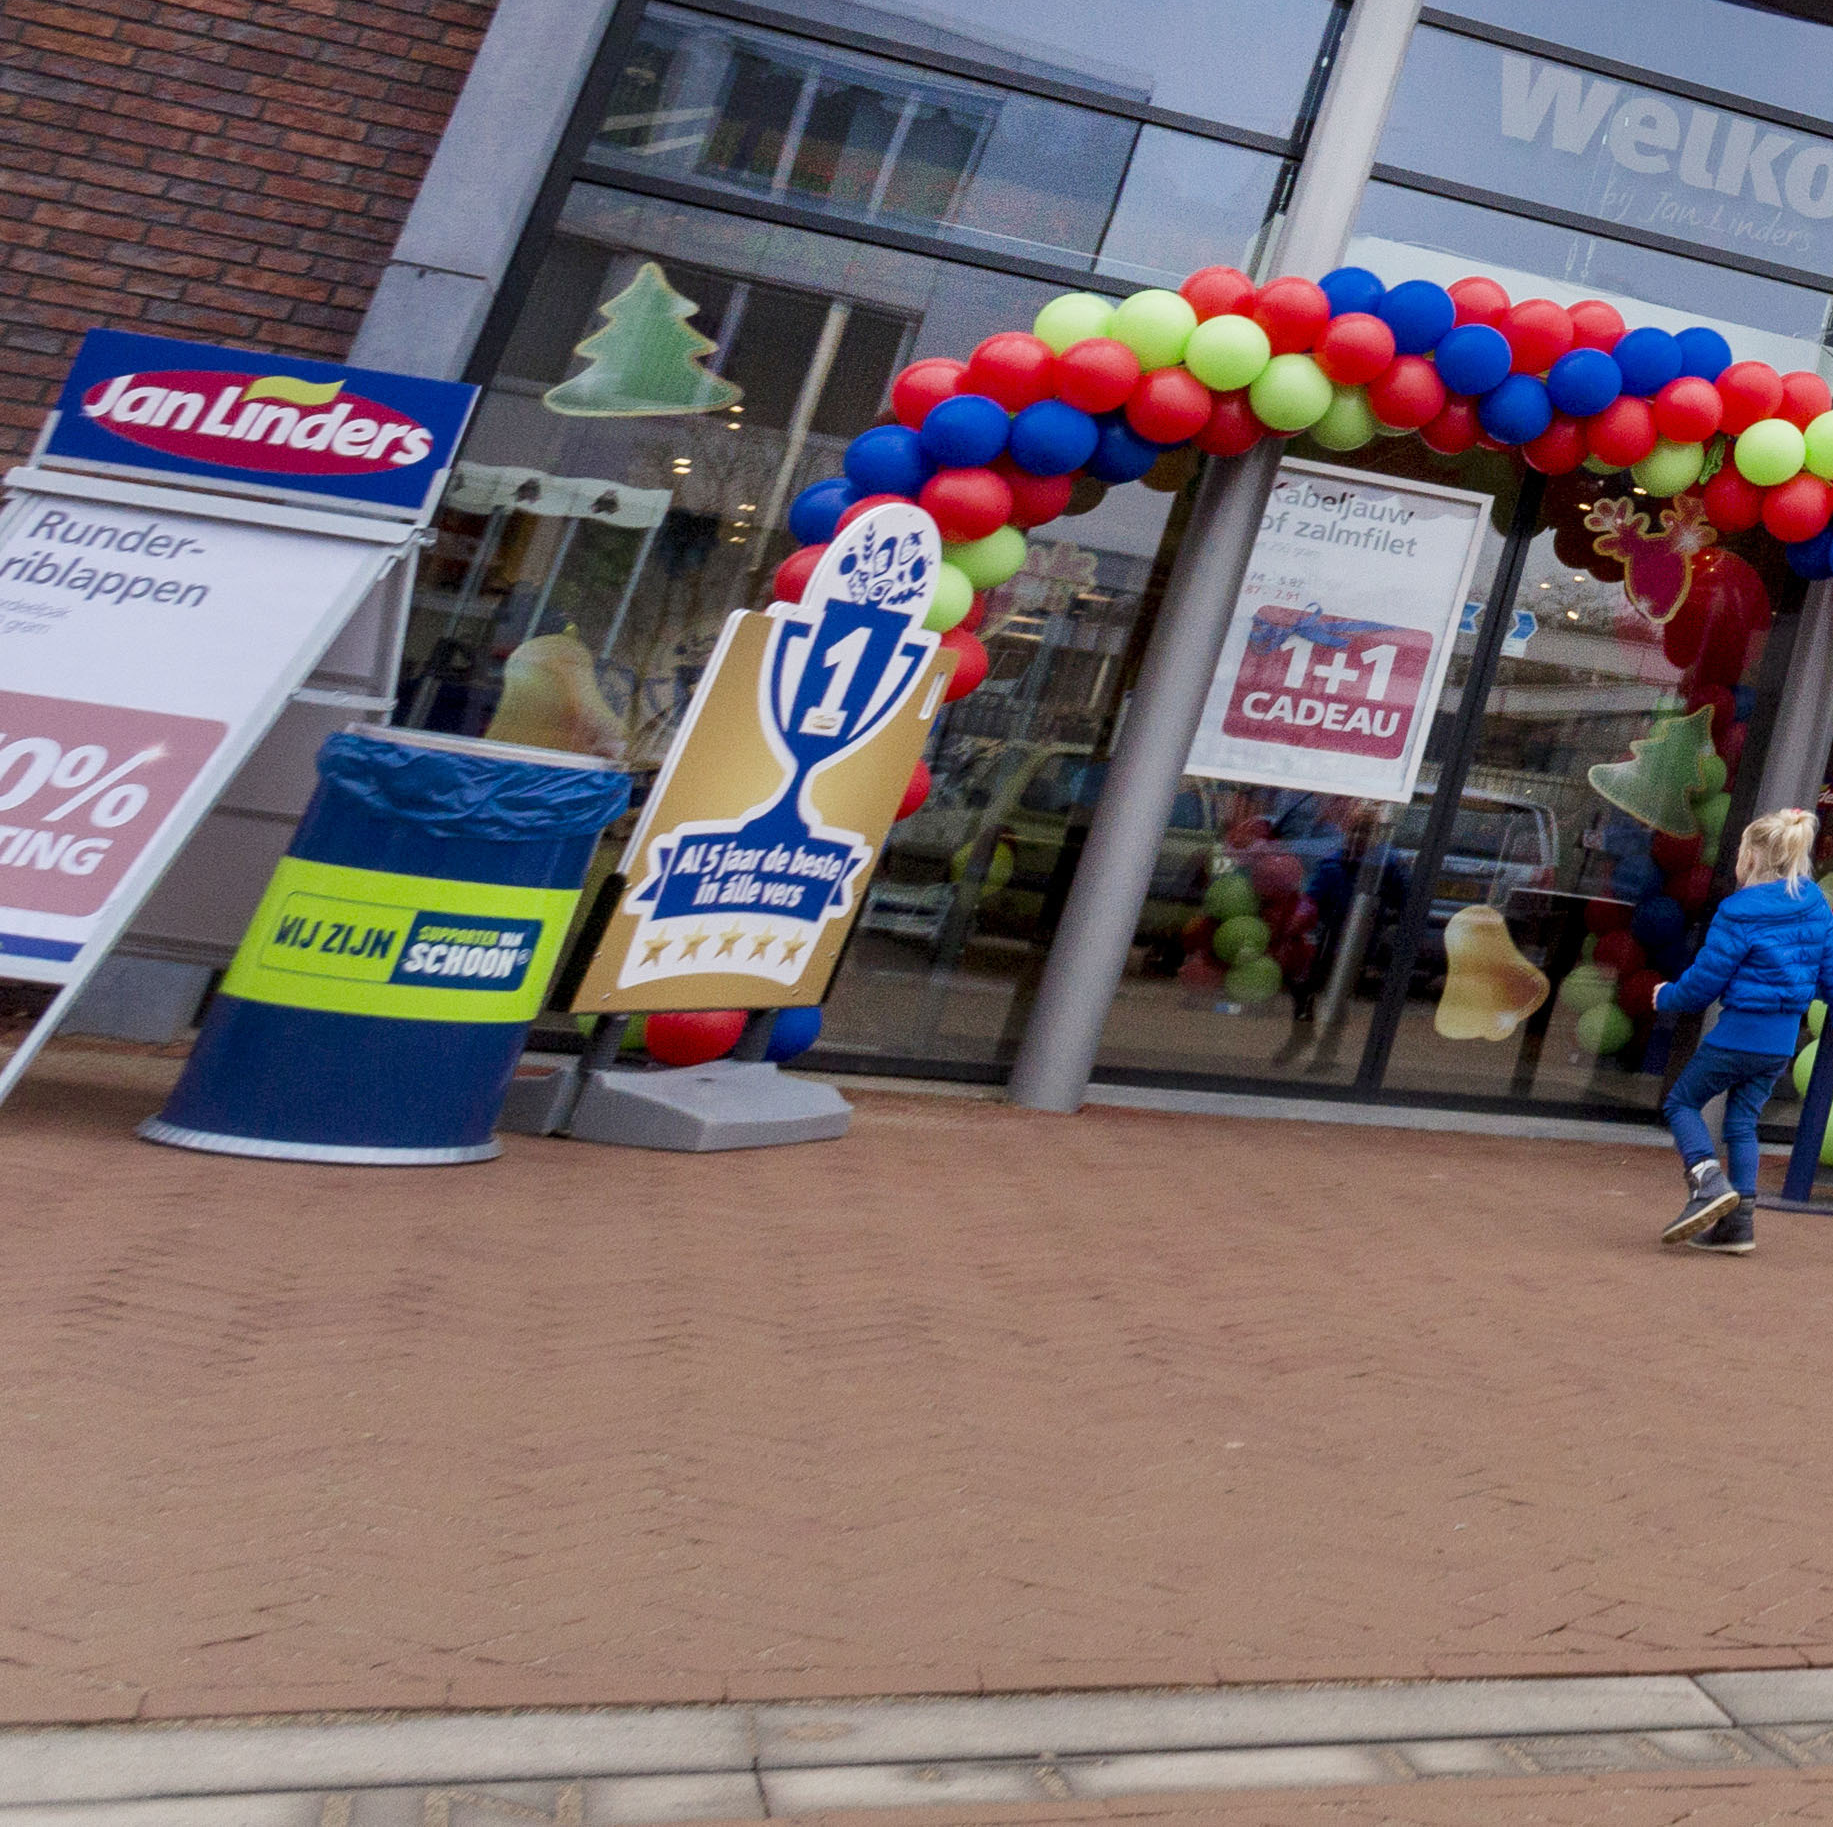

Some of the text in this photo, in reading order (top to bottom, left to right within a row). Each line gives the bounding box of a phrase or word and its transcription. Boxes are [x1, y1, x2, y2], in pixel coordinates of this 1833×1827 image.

[82, 374, 434, 466] Jan Linders
[28, 510, 206, 560] Runder-
[1261, 511, 1290, 533] of
[1295, 521, 1417, 557] zalmfilet
[799, 627, 872, 737] 1
[1280, 634, 1398, 702] 1+1
[1241, 692, 1400, 738] CADEAU
[0, 732, 168, 828] 0%
[672, 841, 843, 881] Al 5 jaar de beste
[692, 875, 721, 906] in
[760, 881, 806, 908] vers
[273, 915, 397, 959] WIJ ZIJN
[417, 925, 500, 947] SUPPORTER
